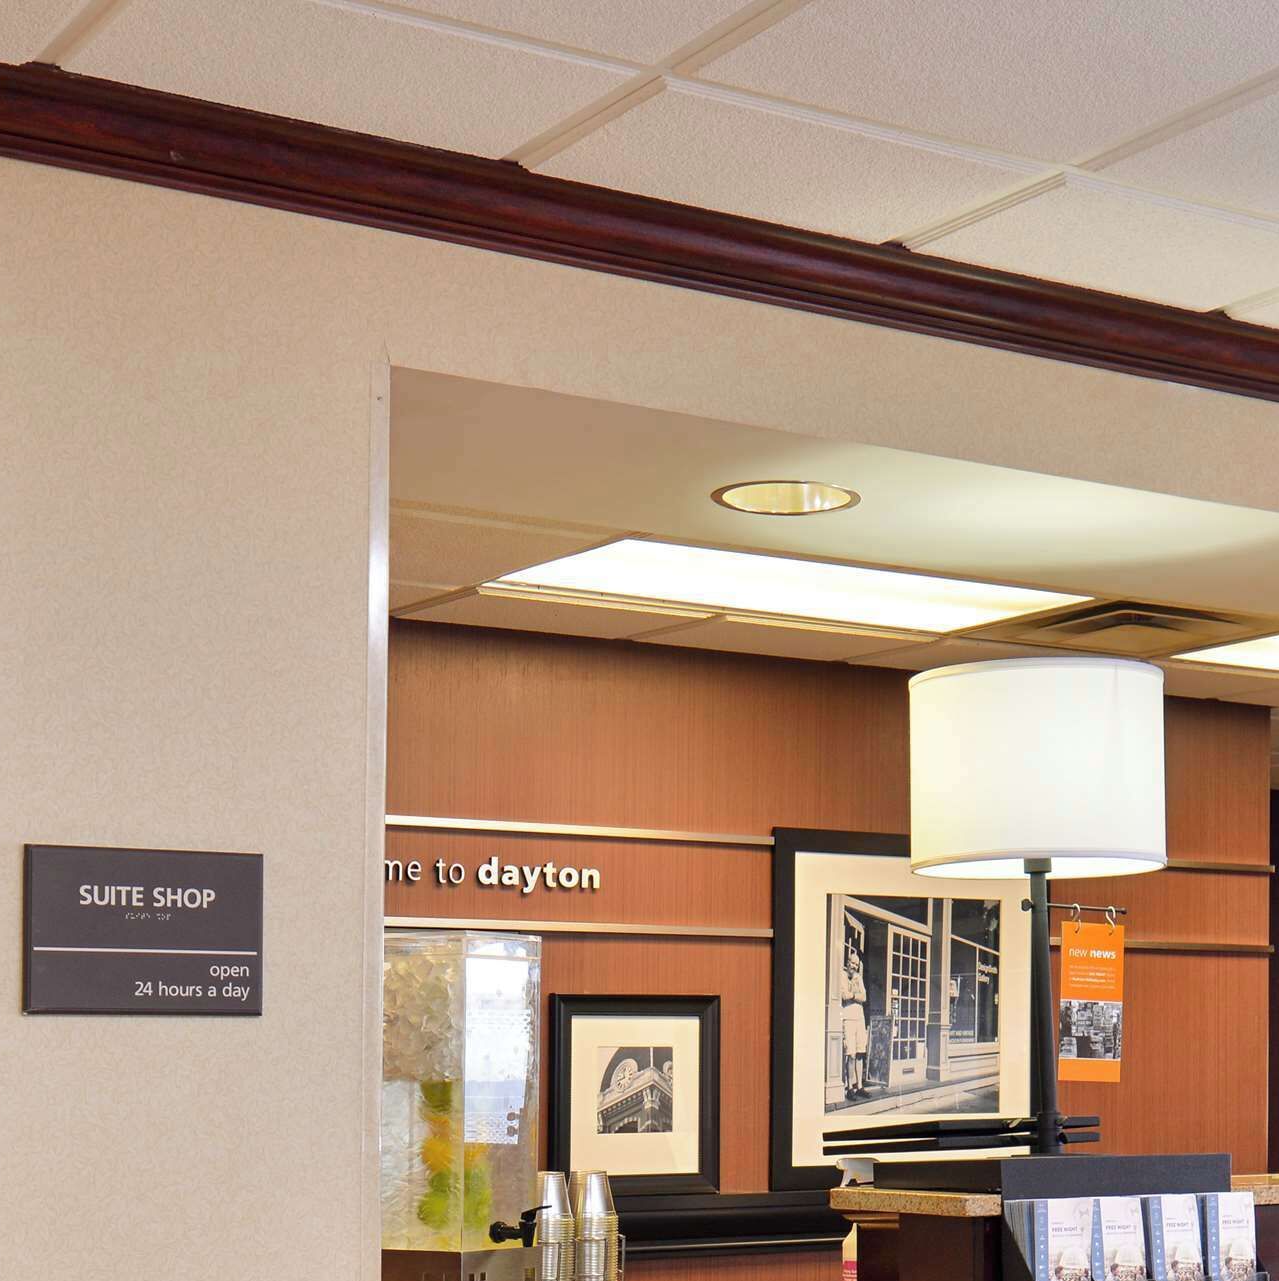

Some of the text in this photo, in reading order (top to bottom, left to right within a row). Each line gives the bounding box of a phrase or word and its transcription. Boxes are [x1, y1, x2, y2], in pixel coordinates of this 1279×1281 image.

[435, 858, 466, 885] to
[477, 856, 601, 894] dayton
[79, 884, 217, 909] SUITE SHOP
[1069, 947, 1117, 960] new news
[209, 964, 250, 981] open
[134, 981, 250, 1001] 24 hours a day
